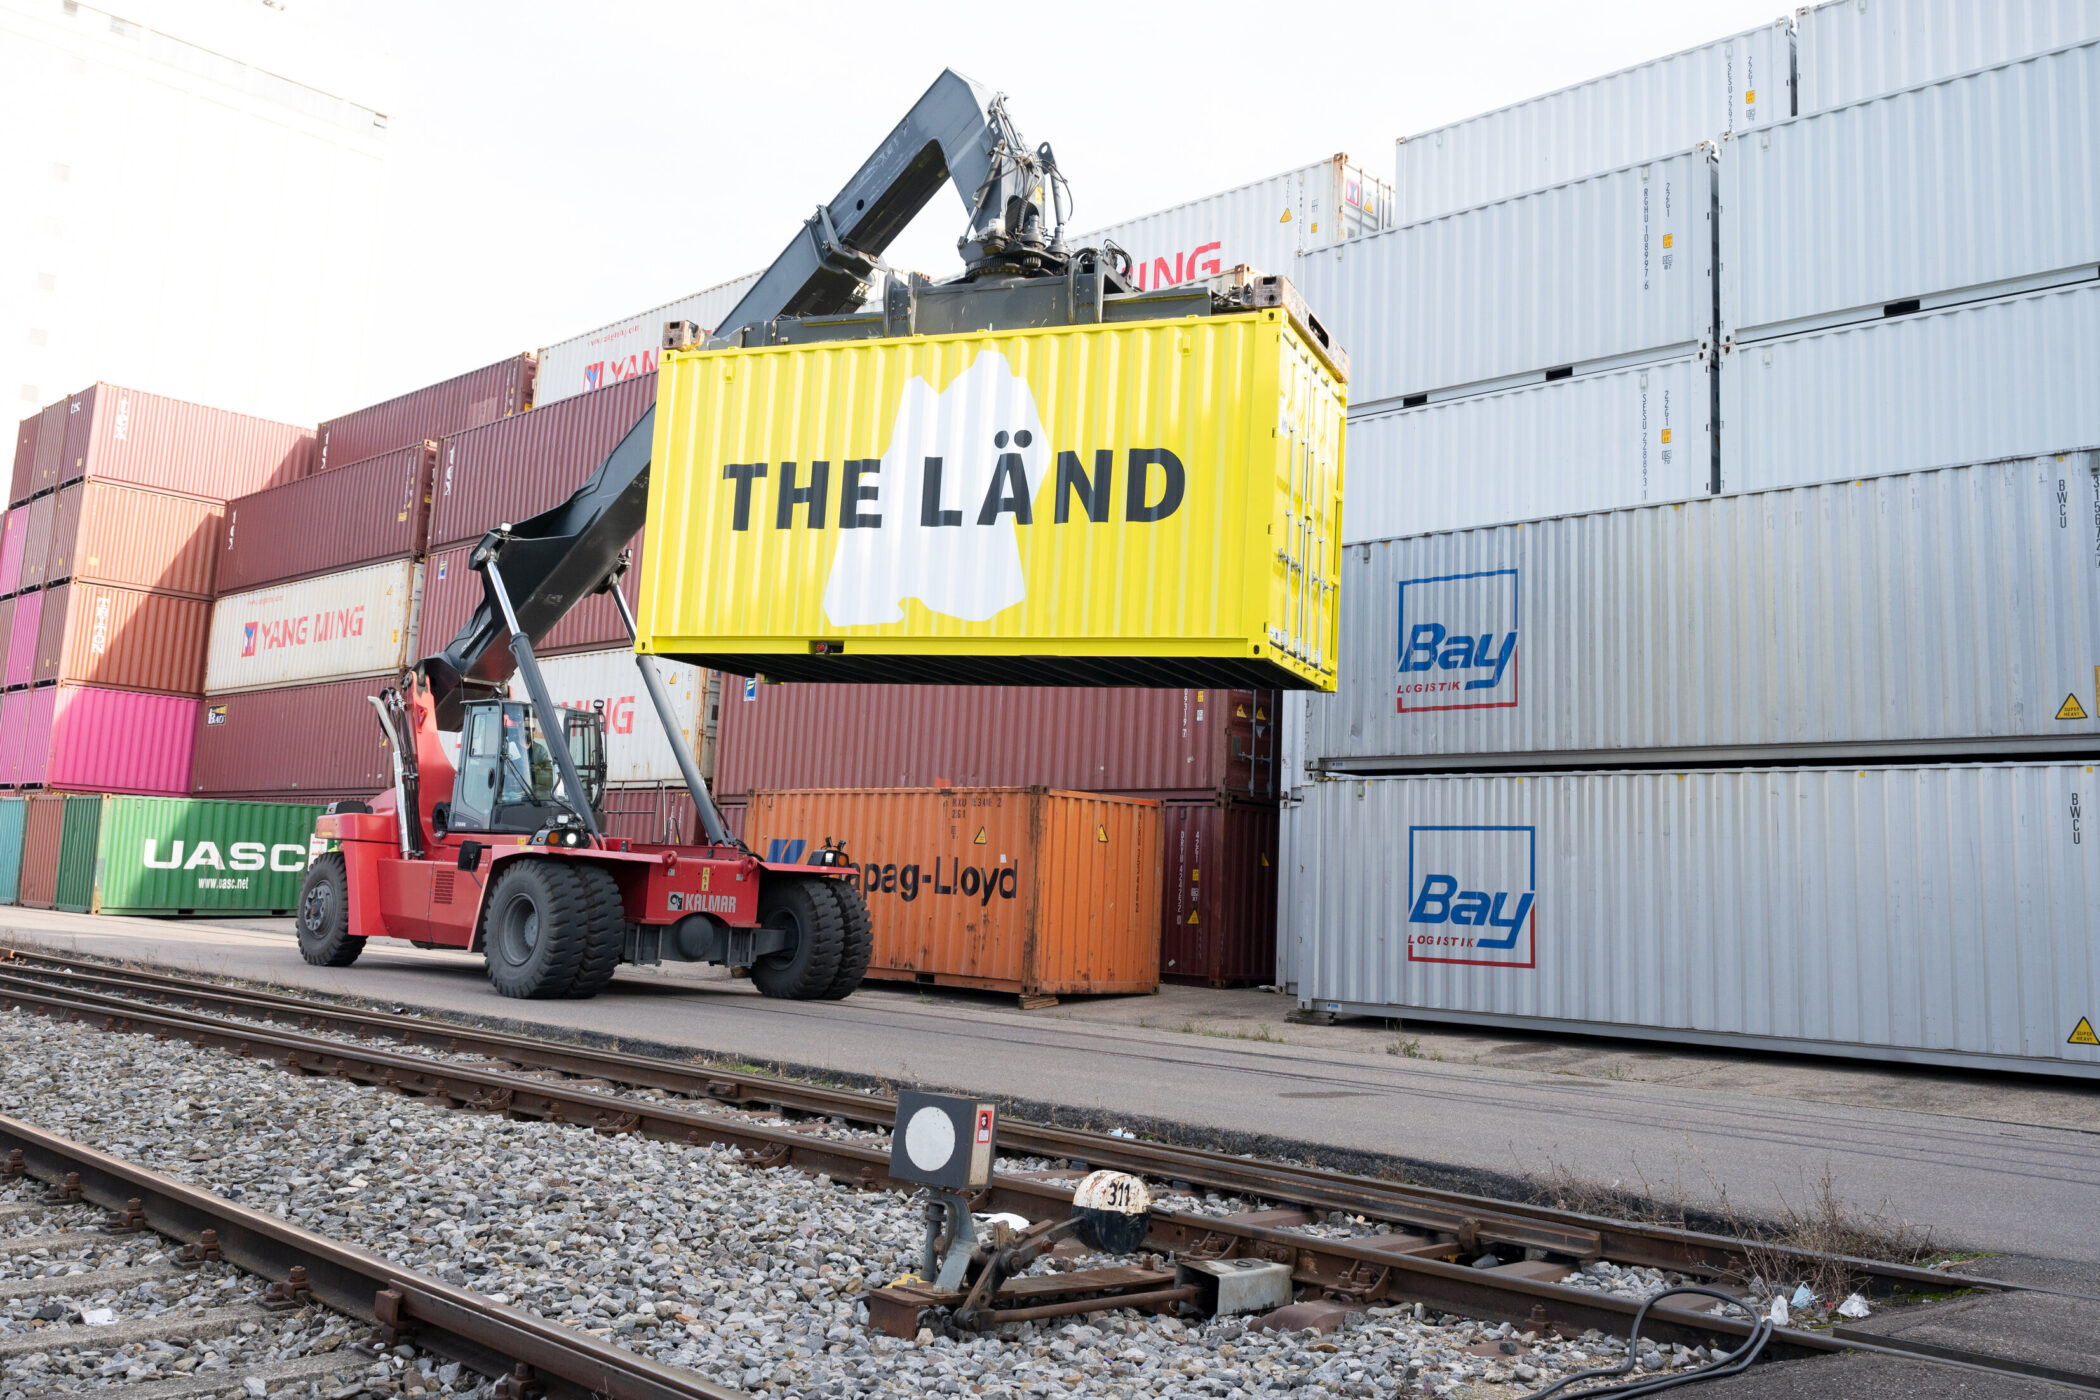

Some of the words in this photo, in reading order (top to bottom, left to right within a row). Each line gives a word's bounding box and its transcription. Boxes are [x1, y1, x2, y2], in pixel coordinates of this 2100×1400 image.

[611, 346, 660, 382] YAN
[723, 459, 882, 531] THE
[921, 430, 1185, 527] LÄND
[2057, 479, 2068, 529] BWCU
[262, 616, 308, 650] YANG
[313, 605, 365, 643] MING
[1398, 623, 1517, 690] Bay
[1397, 681, 1461, 694] LOGISTIK
[2069, 792, 2081, 845] BWCU
[143, 838, 306, 872] UASC
[198, 877, 249, 889] www.uasc.net
[845, 856, 1018, 907] apag-Lloyd
[685, 893, 736, 913] KALMAR
[1408, 874, 1535, 949] Bay
[1408, 934, 1474, 948] LOGISTIK
[1107, 1182, 1130, 1206] 311
